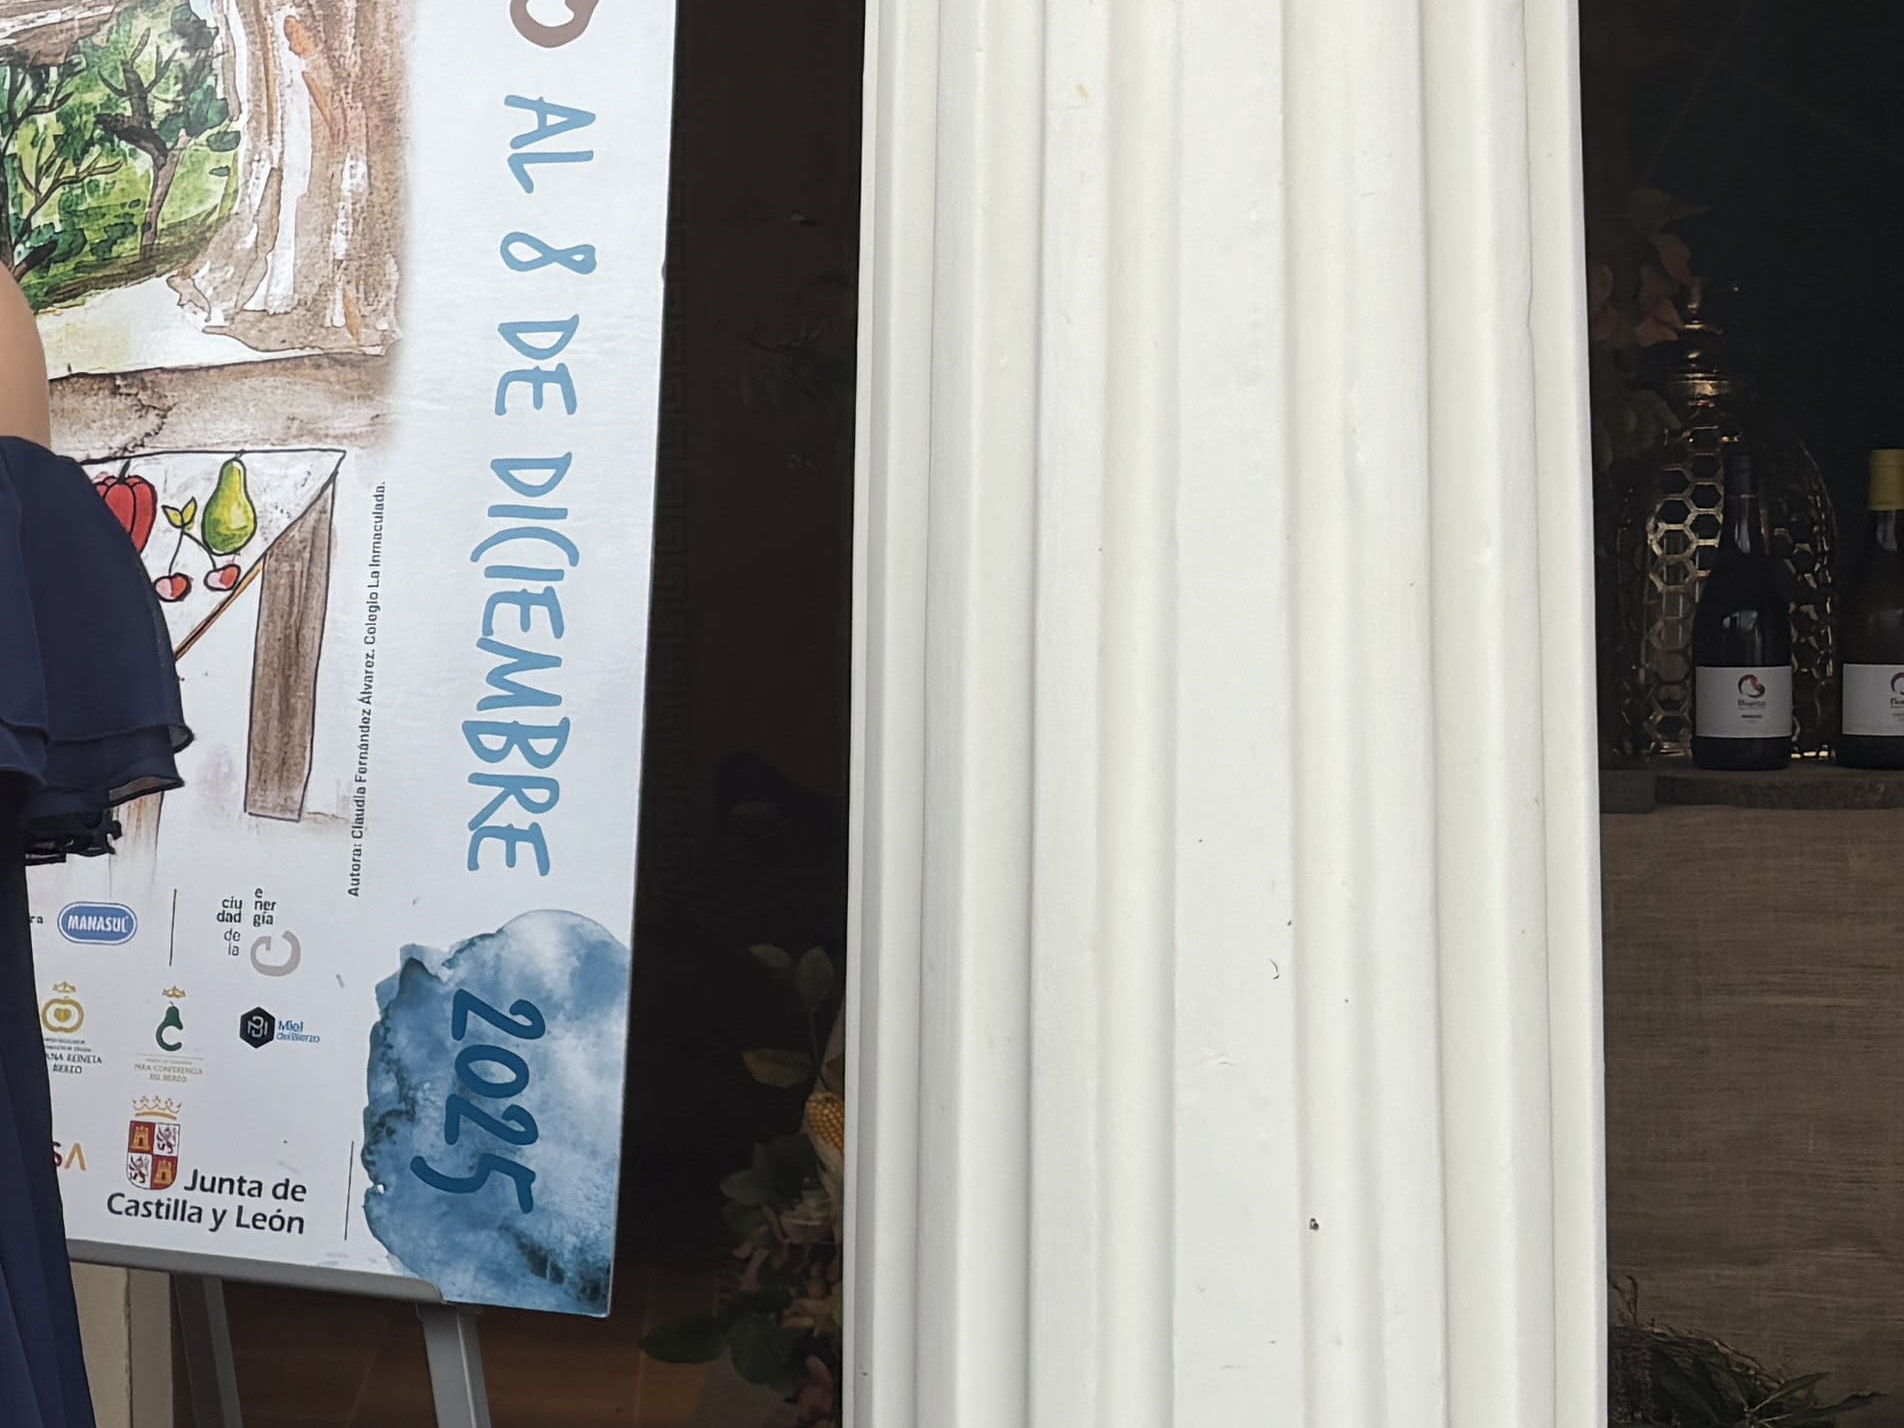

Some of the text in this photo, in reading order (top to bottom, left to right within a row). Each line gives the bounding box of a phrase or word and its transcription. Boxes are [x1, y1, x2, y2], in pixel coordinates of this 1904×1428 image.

[503, 94, 597, 194] AL
[499, 231, 598, 276] 8
[493, 313, 581, 416] DE
[368, 571, 380, 588] La
[364, 591, 381, 645] Colegio
[461, 452, 580, 877] DICIEMBRE
[355, 708, 372, 783] Fernández
[351, 786, 367, 839] Claudia
[347, 843, 362, 897] Autora:
[67, 915, 128, 933] MANASUL
[216, 910, 242, 923] dad
[222, 896, 243, 909] ciu
[224, 927, 241, 942] de
[410, 988, 546, 1214] 2025
[184, 1169, 308, 1202] Junta de
[107, 1192, 305, 1235] Castilla y León
